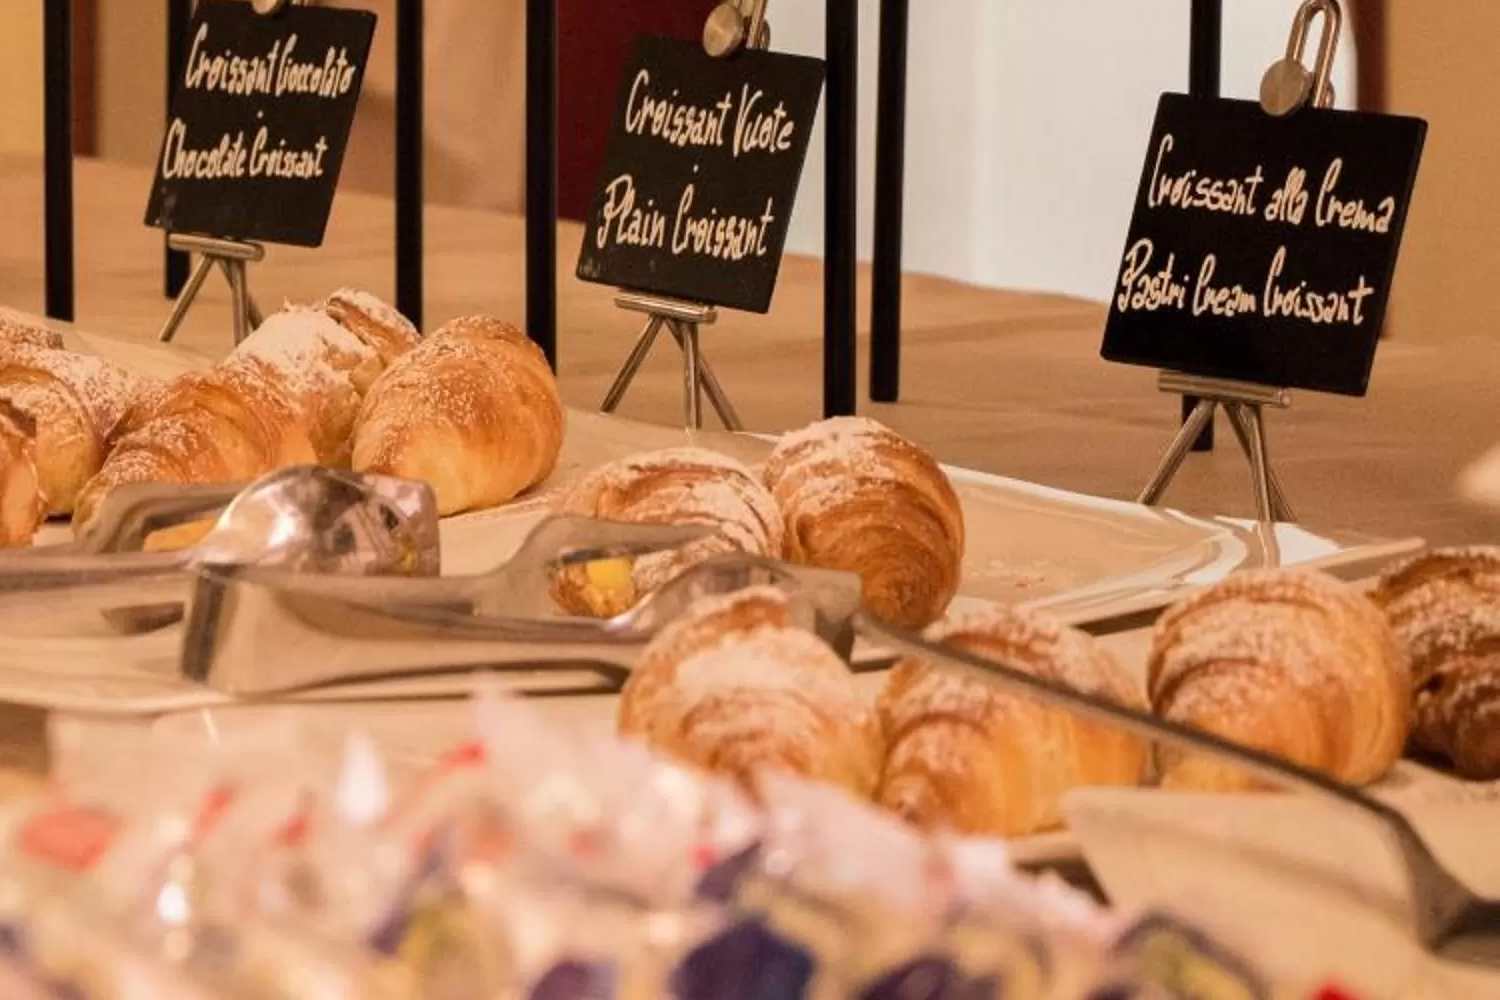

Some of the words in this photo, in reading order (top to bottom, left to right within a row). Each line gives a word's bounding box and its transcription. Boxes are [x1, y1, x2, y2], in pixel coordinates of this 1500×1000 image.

[185, 21, 282, 97] Croissant
[274, 32, 357, 99] Cioccolato
[162, 117, 248, 180] Chocolate
[249, 125, 329, 180] Croissant
[625, 68, 733, 148] Croissant
[596, 173, 666, 250] Plain
[671, 183, 775, 261] Croissant
[1147, 133, 1265, 216] Croissant
[1264, 166, 1310, 226] alla
[1315, 157, 1395, 233] Crema
[1117, 237, 1190, 313] Pastri
[1192, 253, 1258, 318] Cream
[1263, 245, 1375, 326] Croissant
